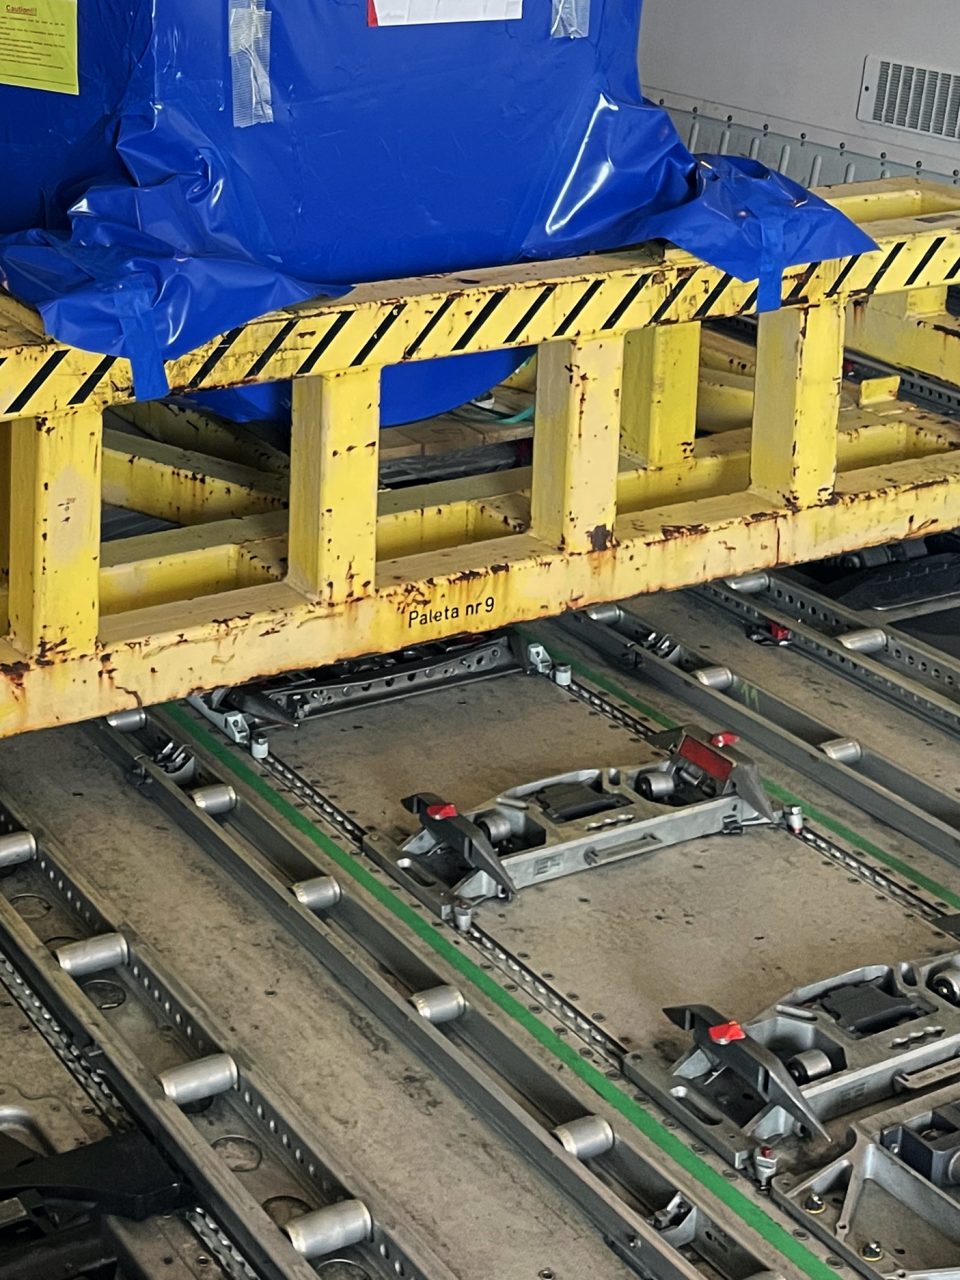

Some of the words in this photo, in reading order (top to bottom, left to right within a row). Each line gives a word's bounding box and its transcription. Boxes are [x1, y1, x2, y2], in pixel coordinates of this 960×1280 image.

[408, 607, 459, 628] Paleta
[465, 602, 482, 616] nr
[485, 596, 495, 613] 9
